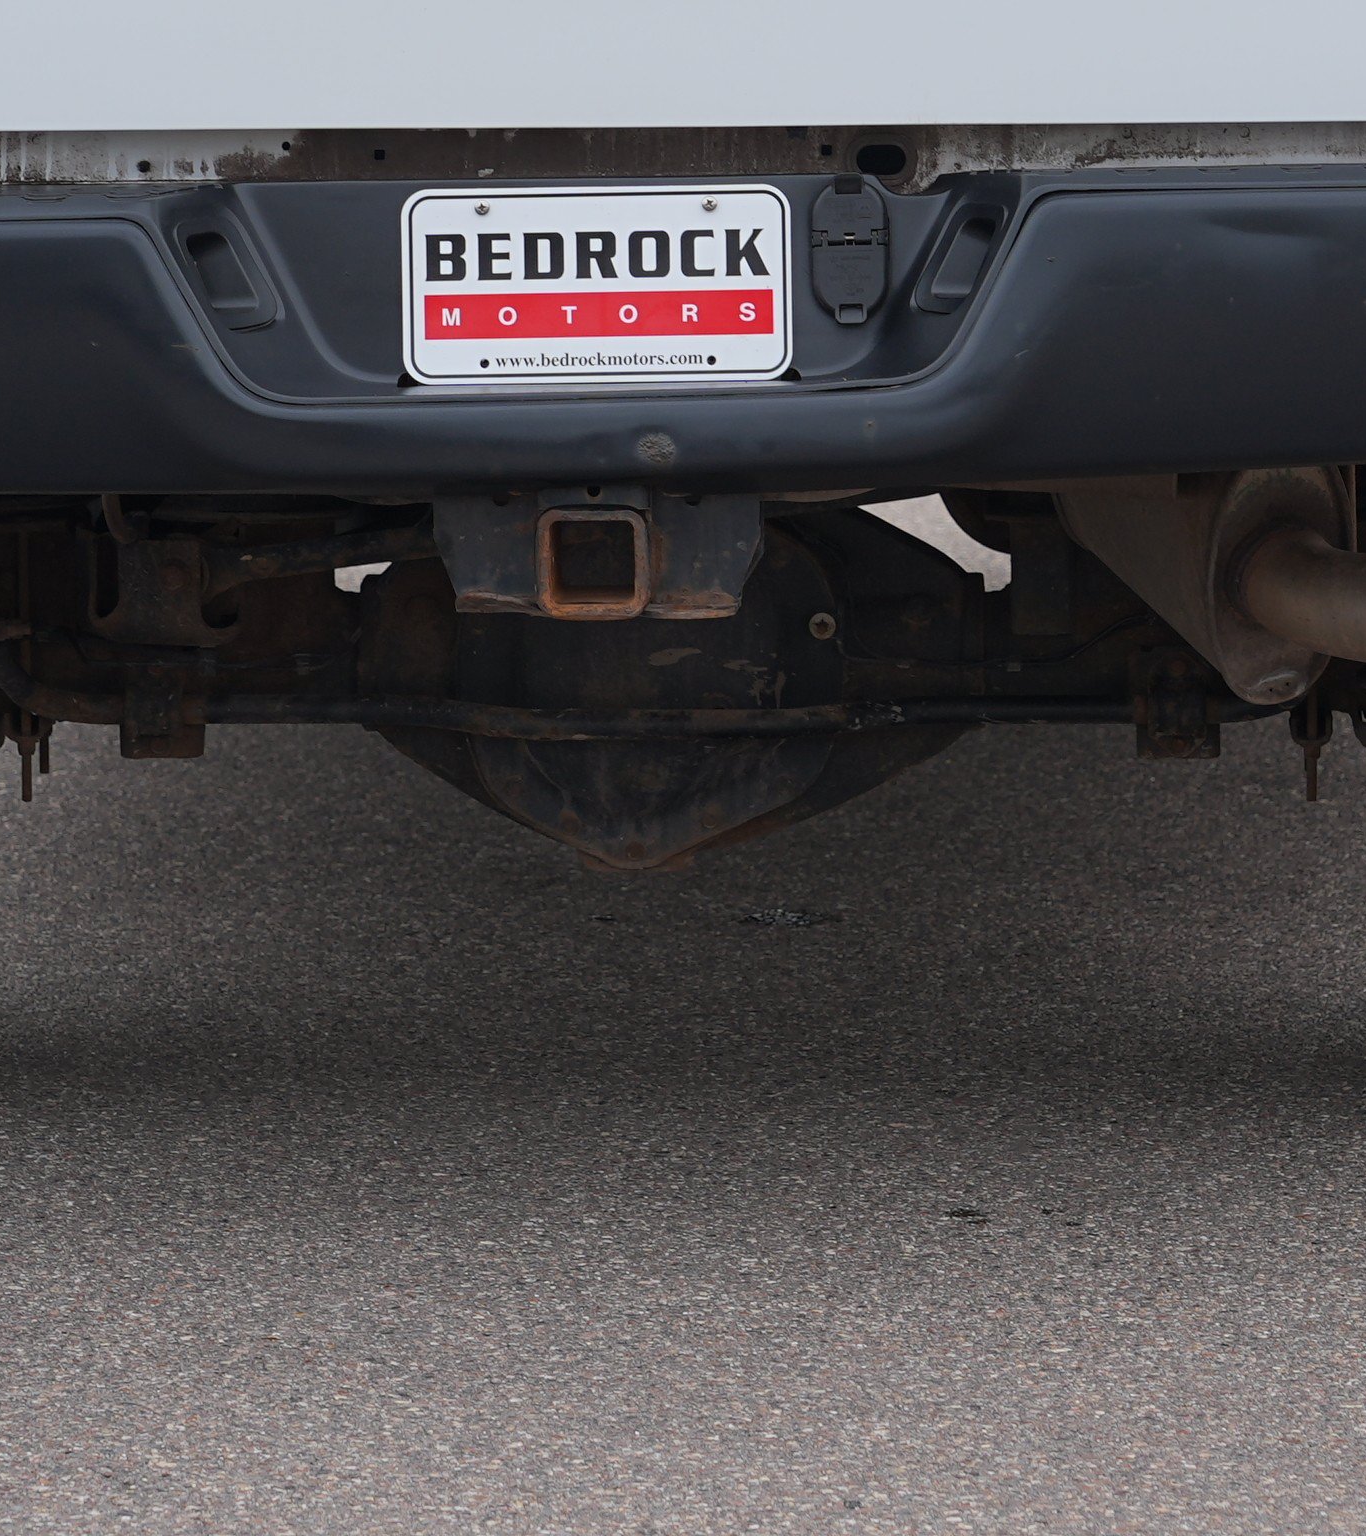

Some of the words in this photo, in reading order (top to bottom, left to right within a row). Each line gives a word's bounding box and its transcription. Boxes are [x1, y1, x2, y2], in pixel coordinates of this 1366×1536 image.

[425, 228, 770, 282] BEDROCK
[441, 302, 757, 327] MOTORS
[495, 350, 704, 371] www.bedrockmotors.com
